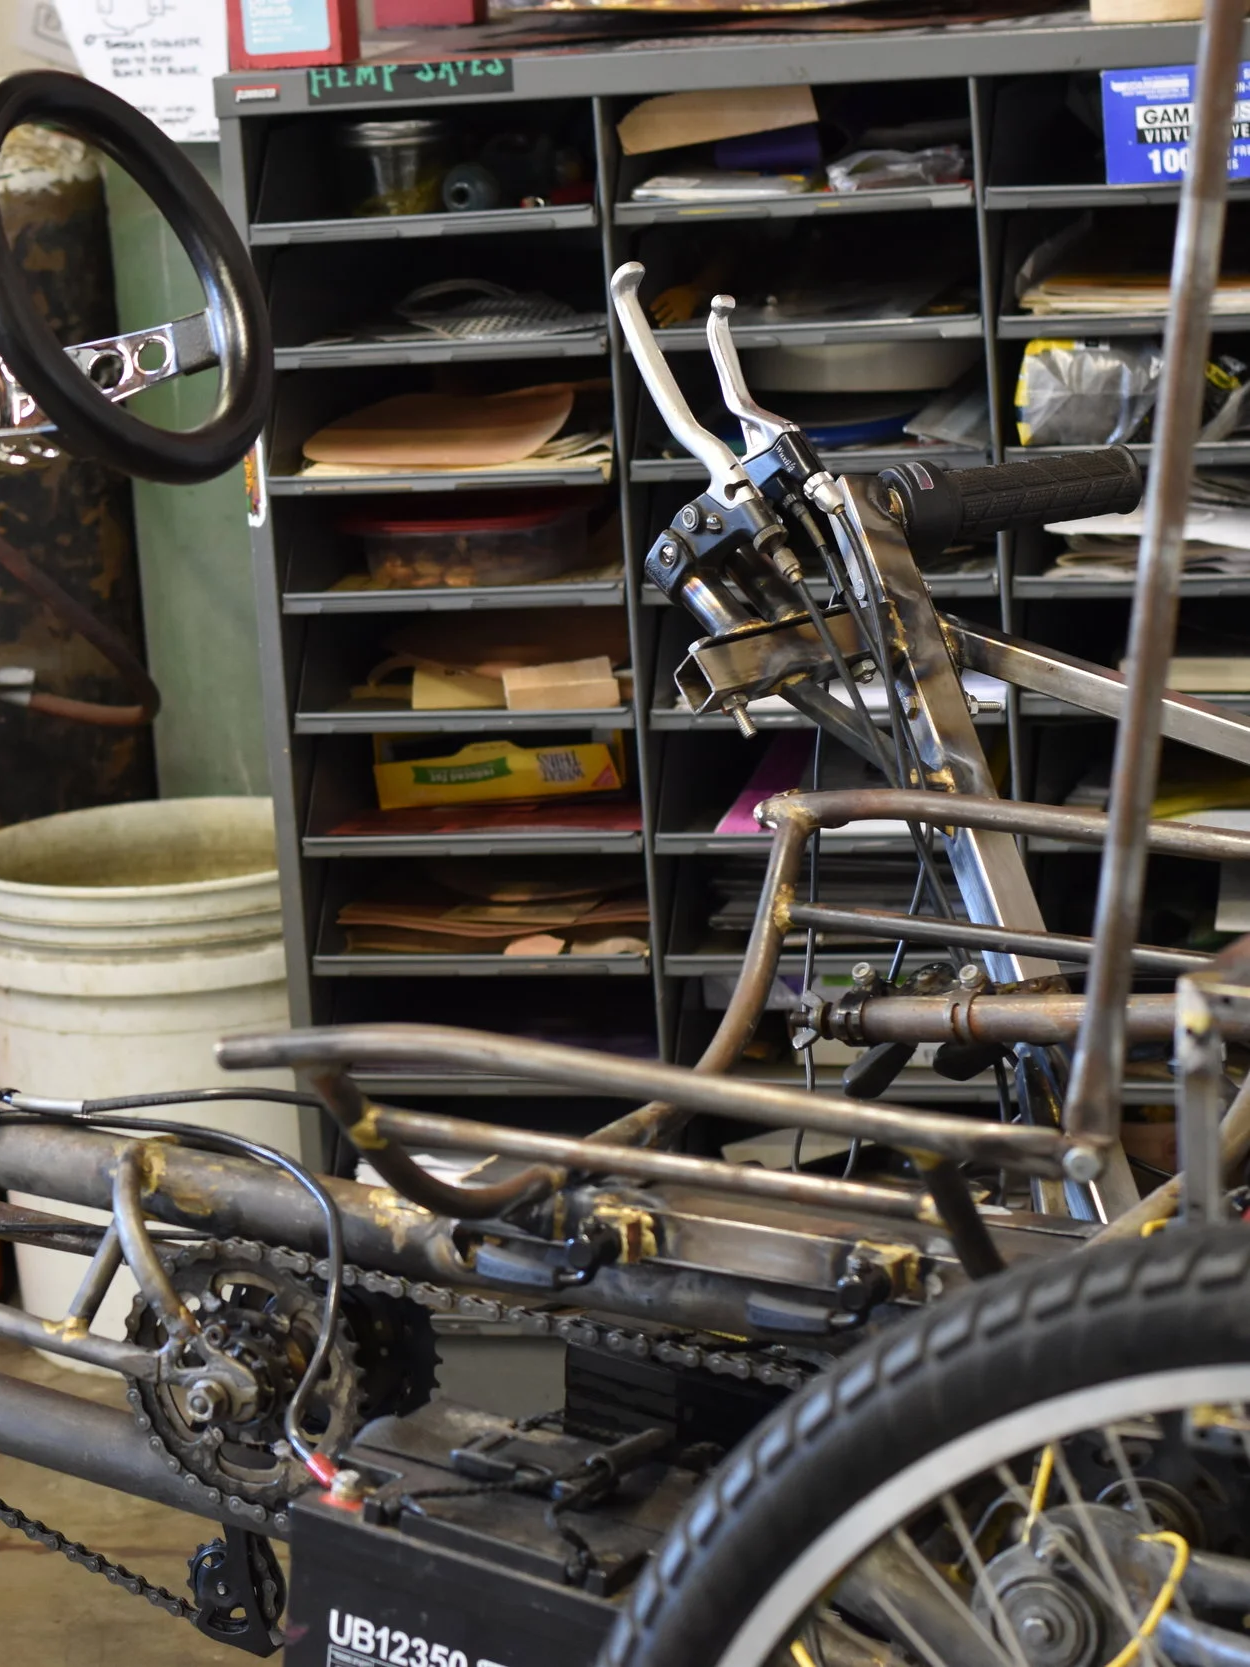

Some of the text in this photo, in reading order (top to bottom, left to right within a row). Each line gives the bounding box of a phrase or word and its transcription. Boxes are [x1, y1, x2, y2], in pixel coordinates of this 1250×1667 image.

[309, 64, 400, 98] HEMP
[415, 58, 506, 88] SAVES
[1143, 107, 1191, 125] GAM
